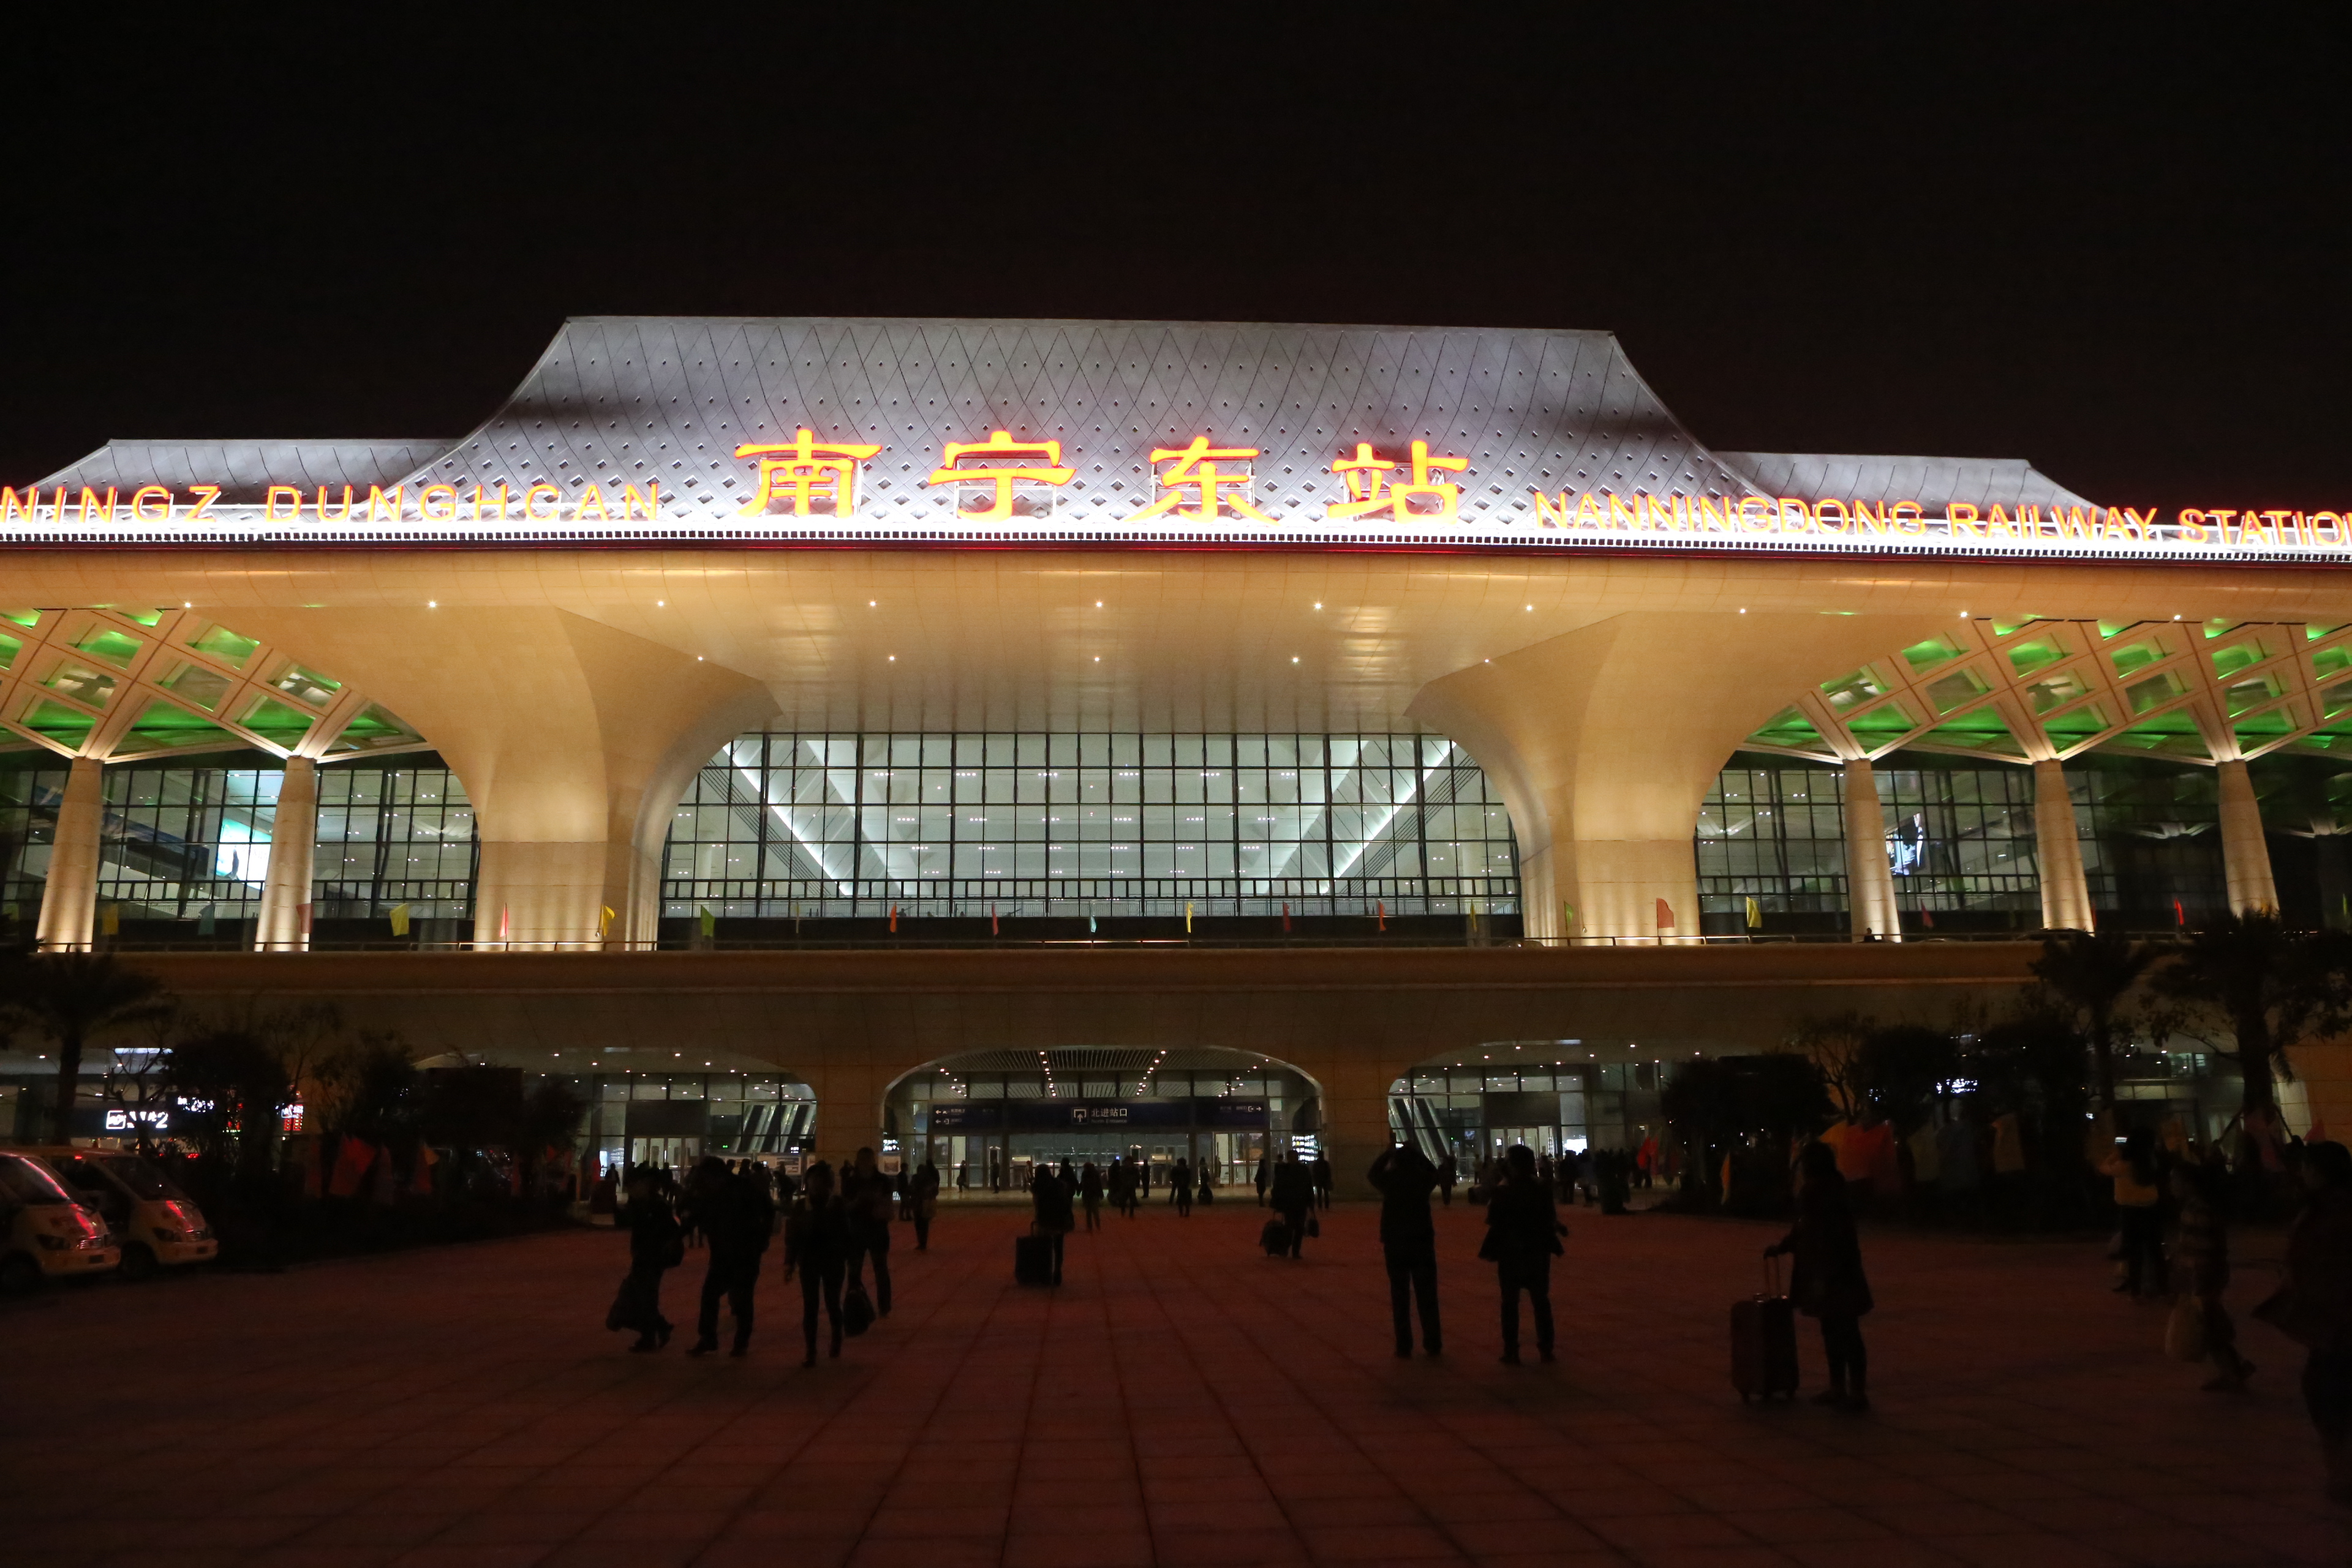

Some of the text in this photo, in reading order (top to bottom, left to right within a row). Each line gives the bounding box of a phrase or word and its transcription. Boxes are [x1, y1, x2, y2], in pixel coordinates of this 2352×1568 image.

[734, 429, 1469, 525] 南宁东站
[0, 484, 659, 522] NINGZ DUNGHCAN
[1535, 491, 2352, 546] NANNINGDONG RAILWAY STATIO
[1091, 1107, 1127, 1117] 北进站口
